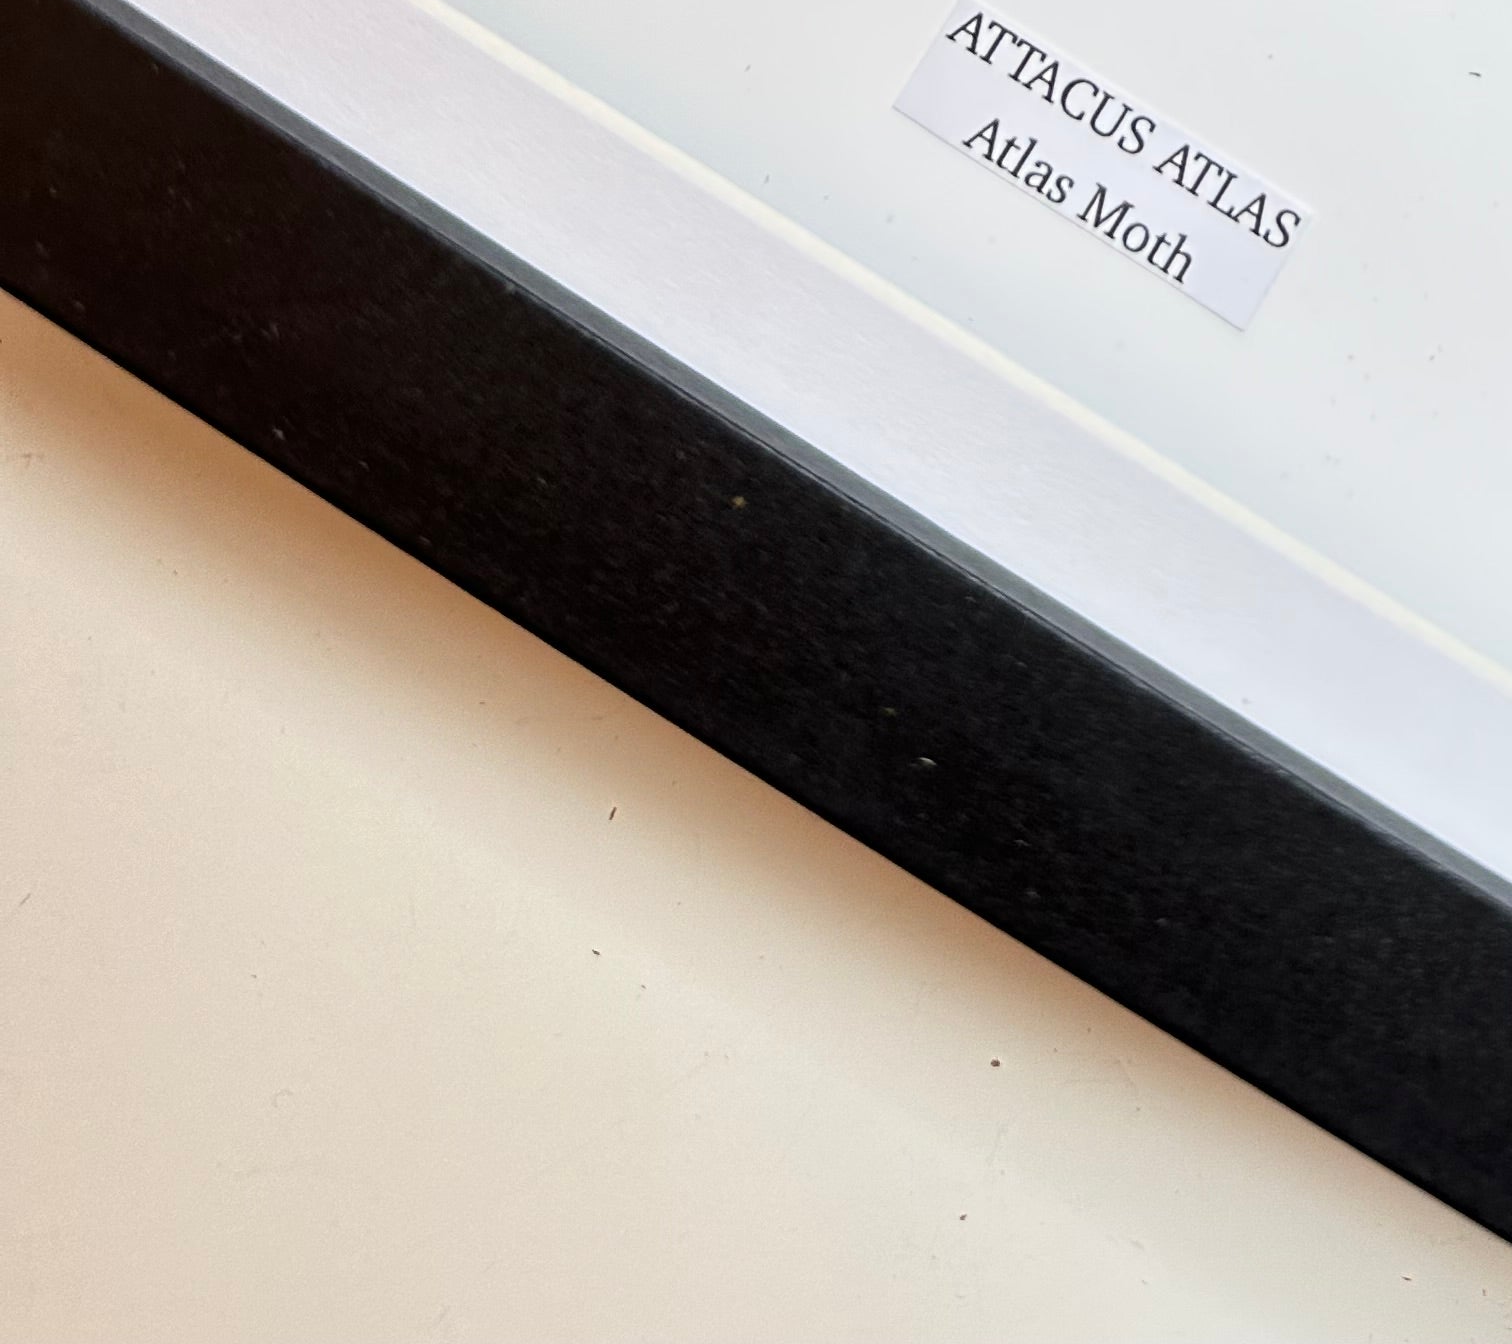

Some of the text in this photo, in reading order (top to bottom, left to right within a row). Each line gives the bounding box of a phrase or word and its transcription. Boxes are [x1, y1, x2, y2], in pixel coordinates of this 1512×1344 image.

[944, 11, 1302, 249] ATTACUS ATLAS
[961, 118, 1193, 285] Atlas Moth
